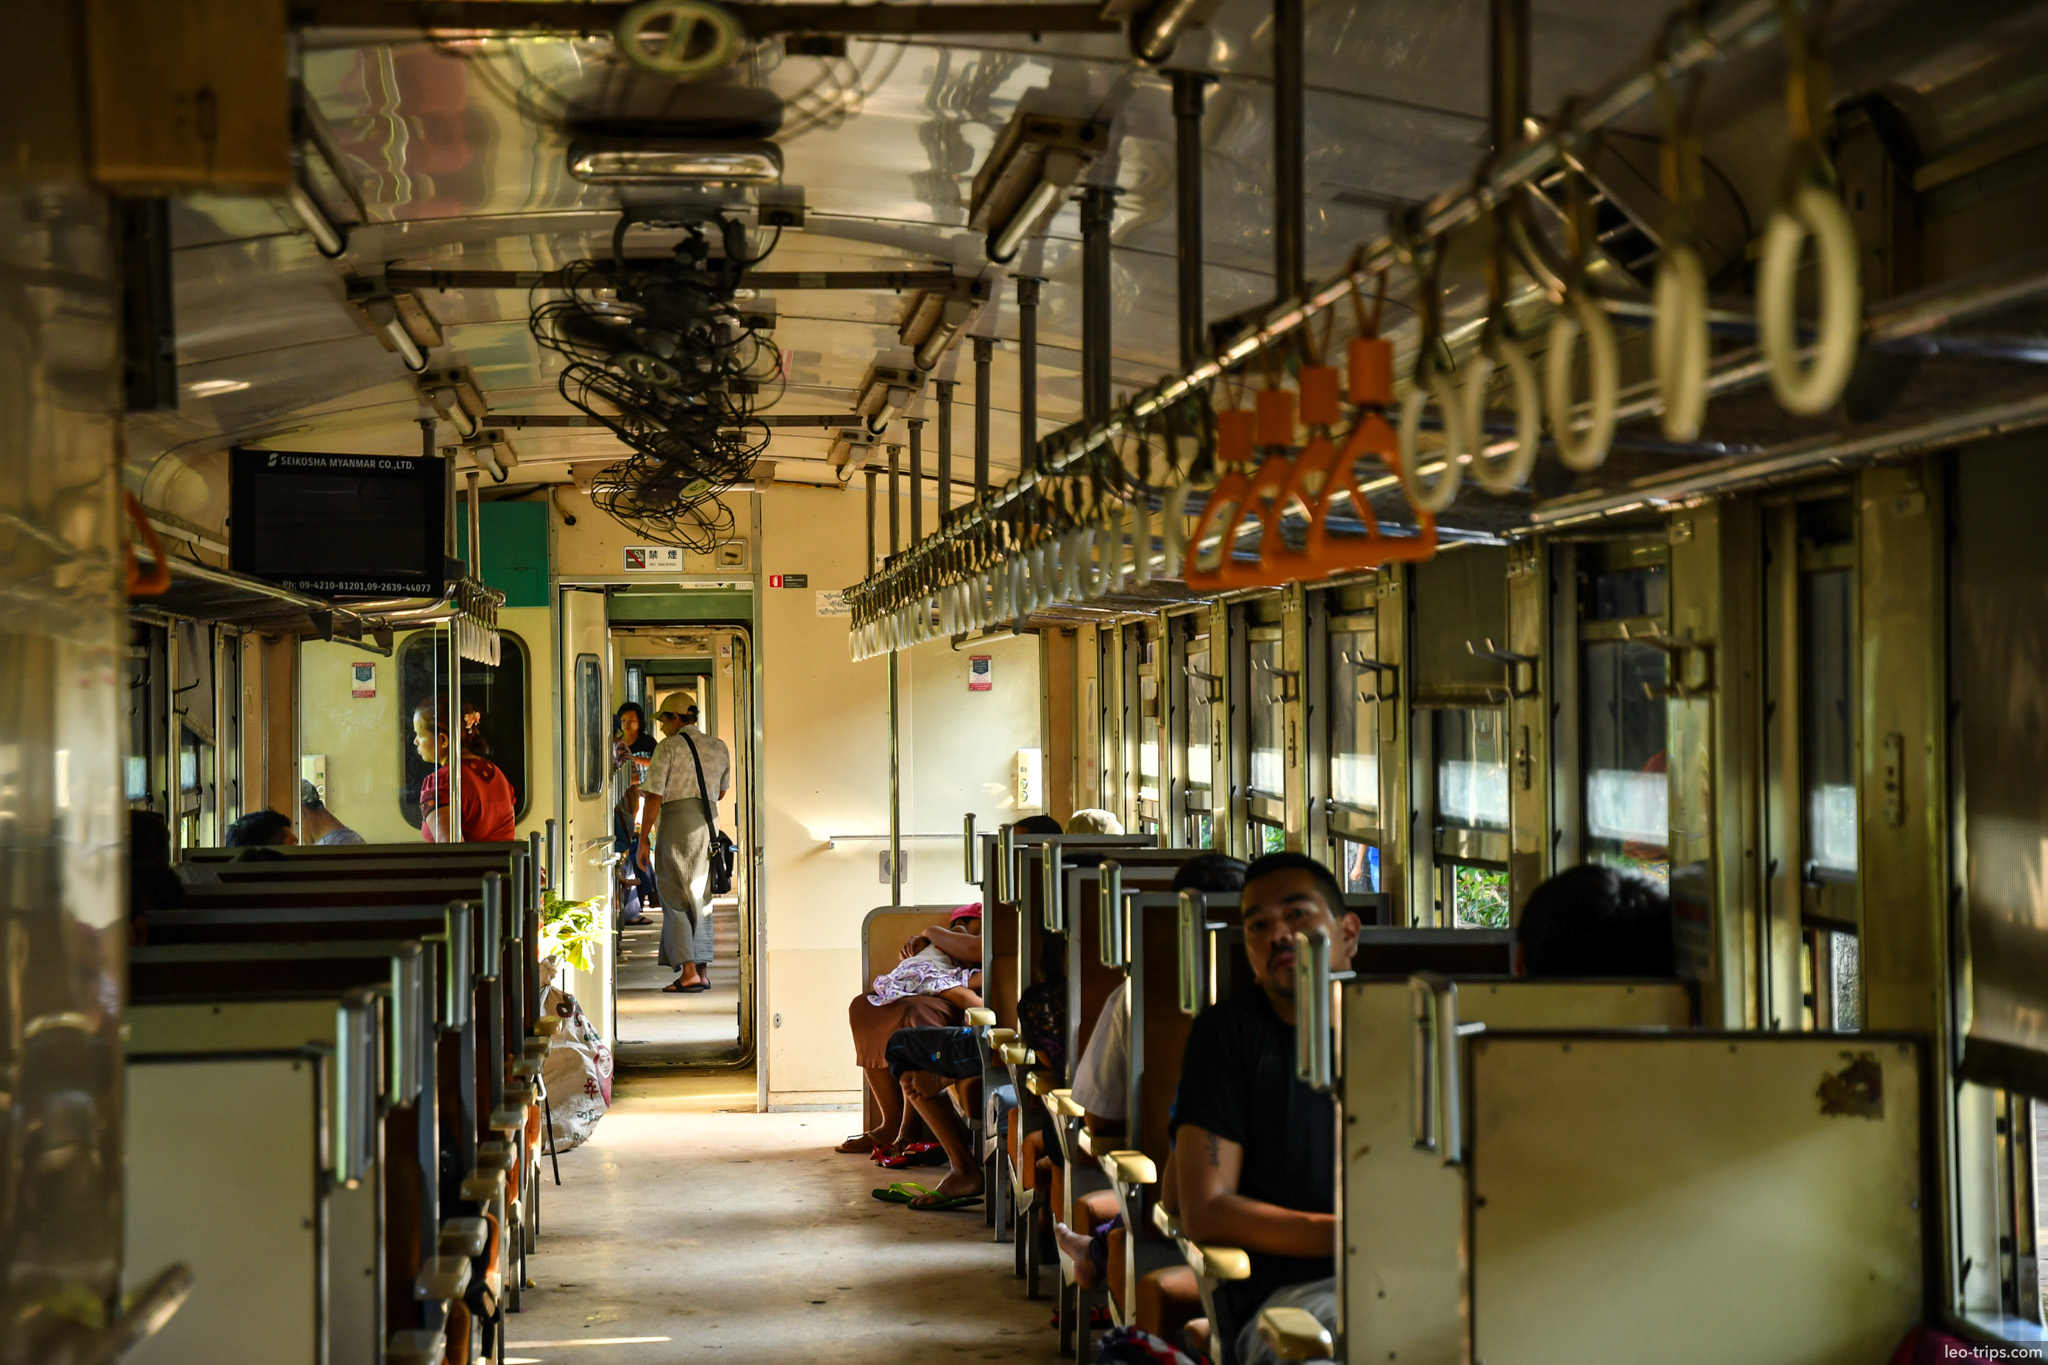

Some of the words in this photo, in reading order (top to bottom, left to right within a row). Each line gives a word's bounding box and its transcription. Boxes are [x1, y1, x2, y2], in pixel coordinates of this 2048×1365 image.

[281, 456, 326, 467] SEIKOSHA
[329, 458, 376, 468] MYANMAR
[378, 460, 415, 470] CO.,LTD.
